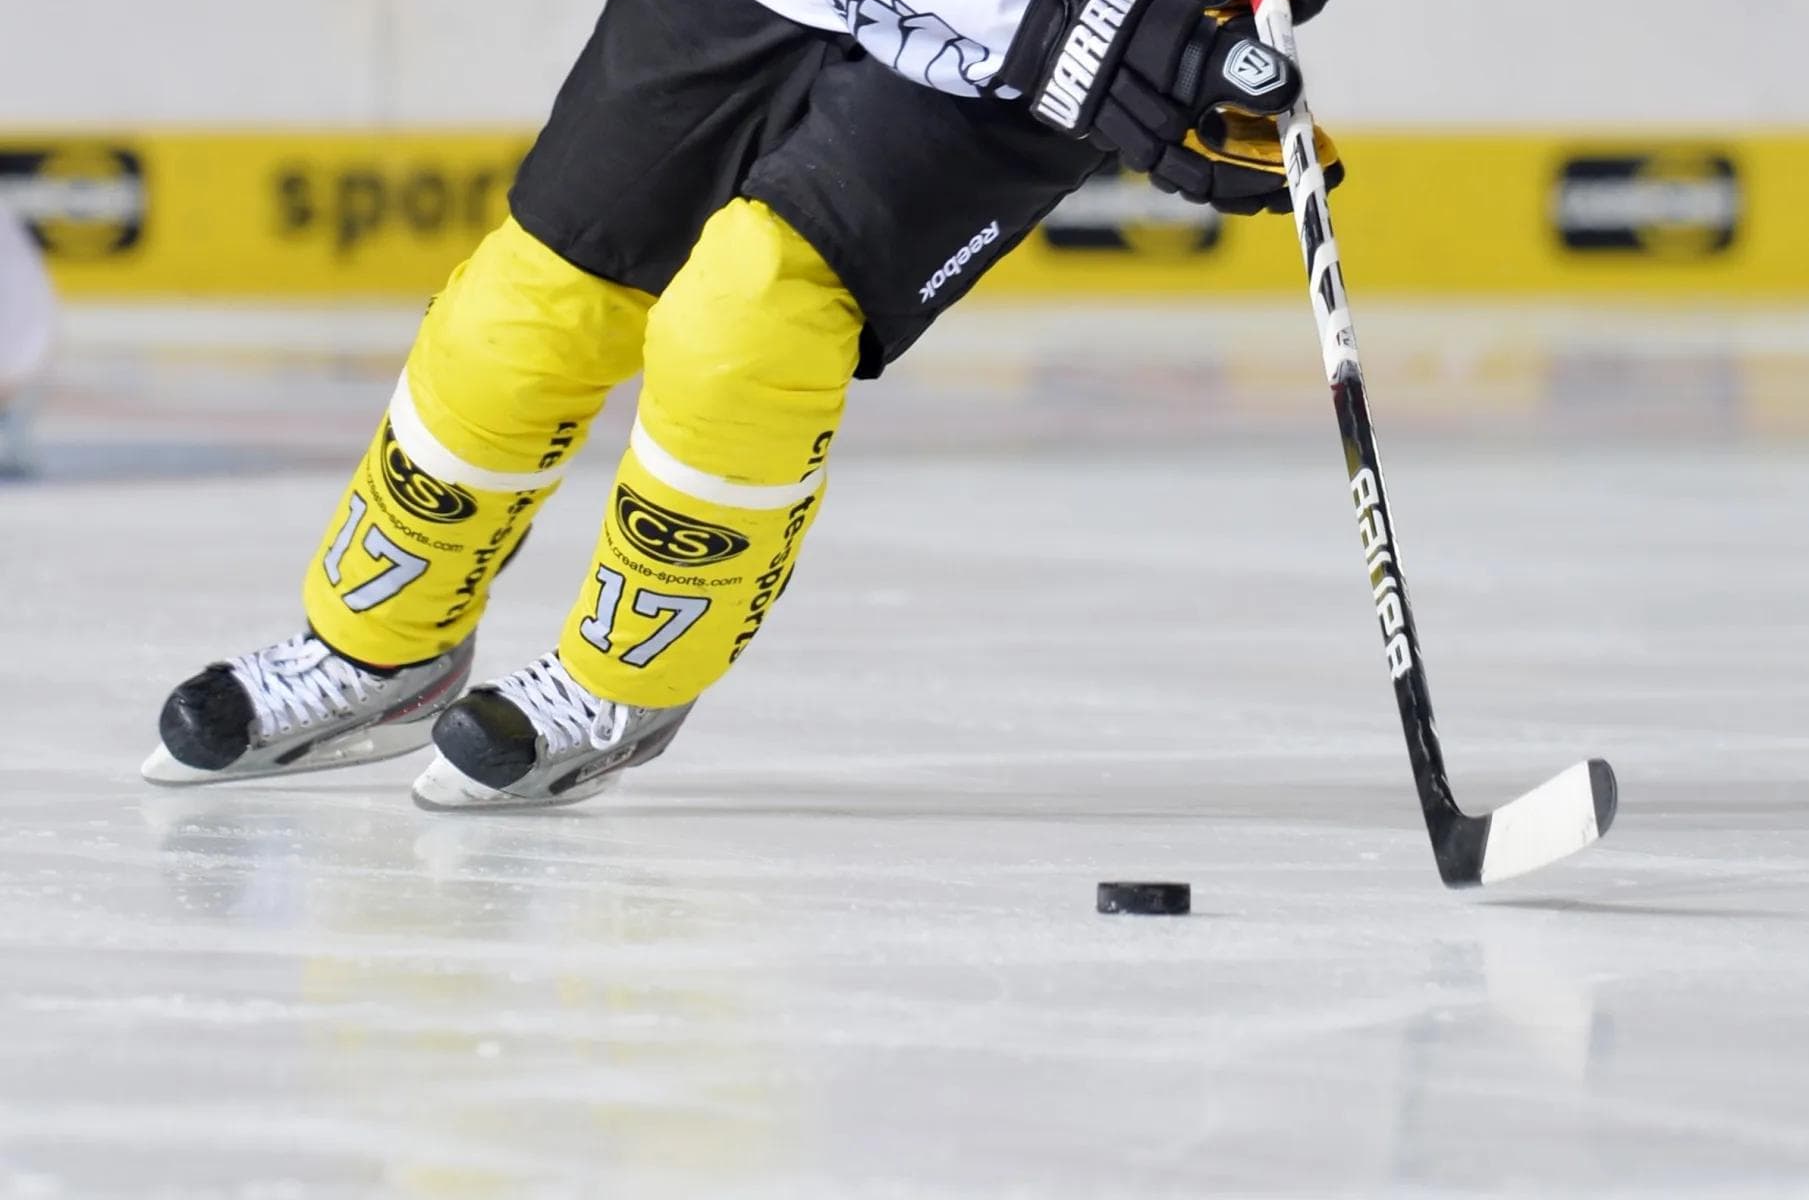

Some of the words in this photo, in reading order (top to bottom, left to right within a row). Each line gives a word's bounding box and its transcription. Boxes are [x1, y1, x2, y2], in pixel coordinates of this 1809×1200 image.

[918, 219, 1000, 304] Reebok
[323, 489, 432, 615] 17
[579, 562, 713, 670] 17
